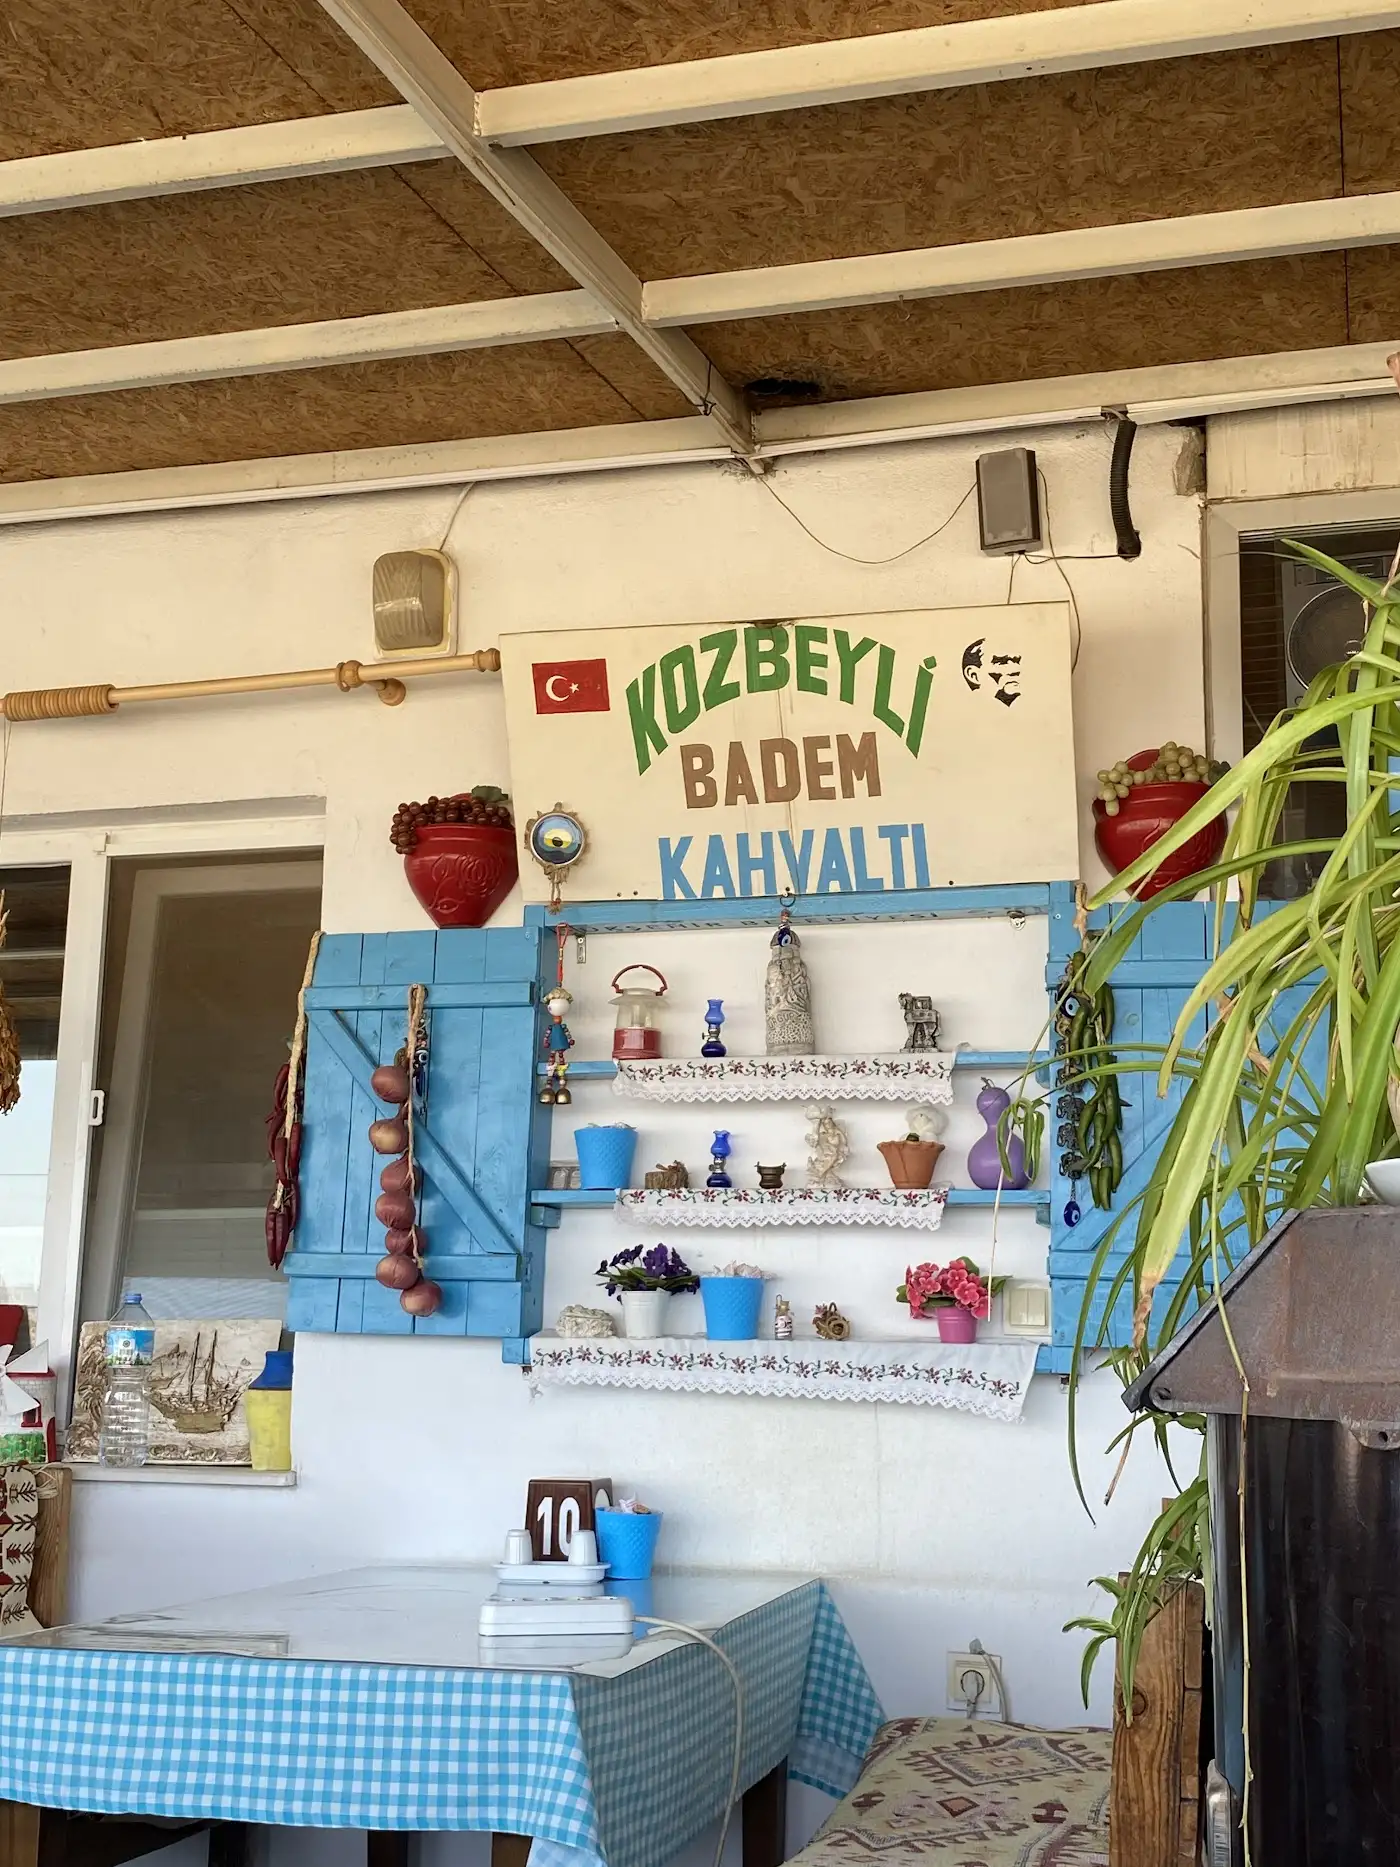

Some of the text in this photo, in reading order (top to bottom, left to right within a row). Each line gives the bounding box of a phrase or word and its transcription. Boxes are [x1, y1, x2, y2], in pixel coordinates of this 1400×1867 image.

[625, 625, 937, 775] KOZBEYLİ
[680, 731, 882, 809] BADEM
[658, 823, 931, 899] KAHVALTI
[537, 1496, 580, 1557] 10
